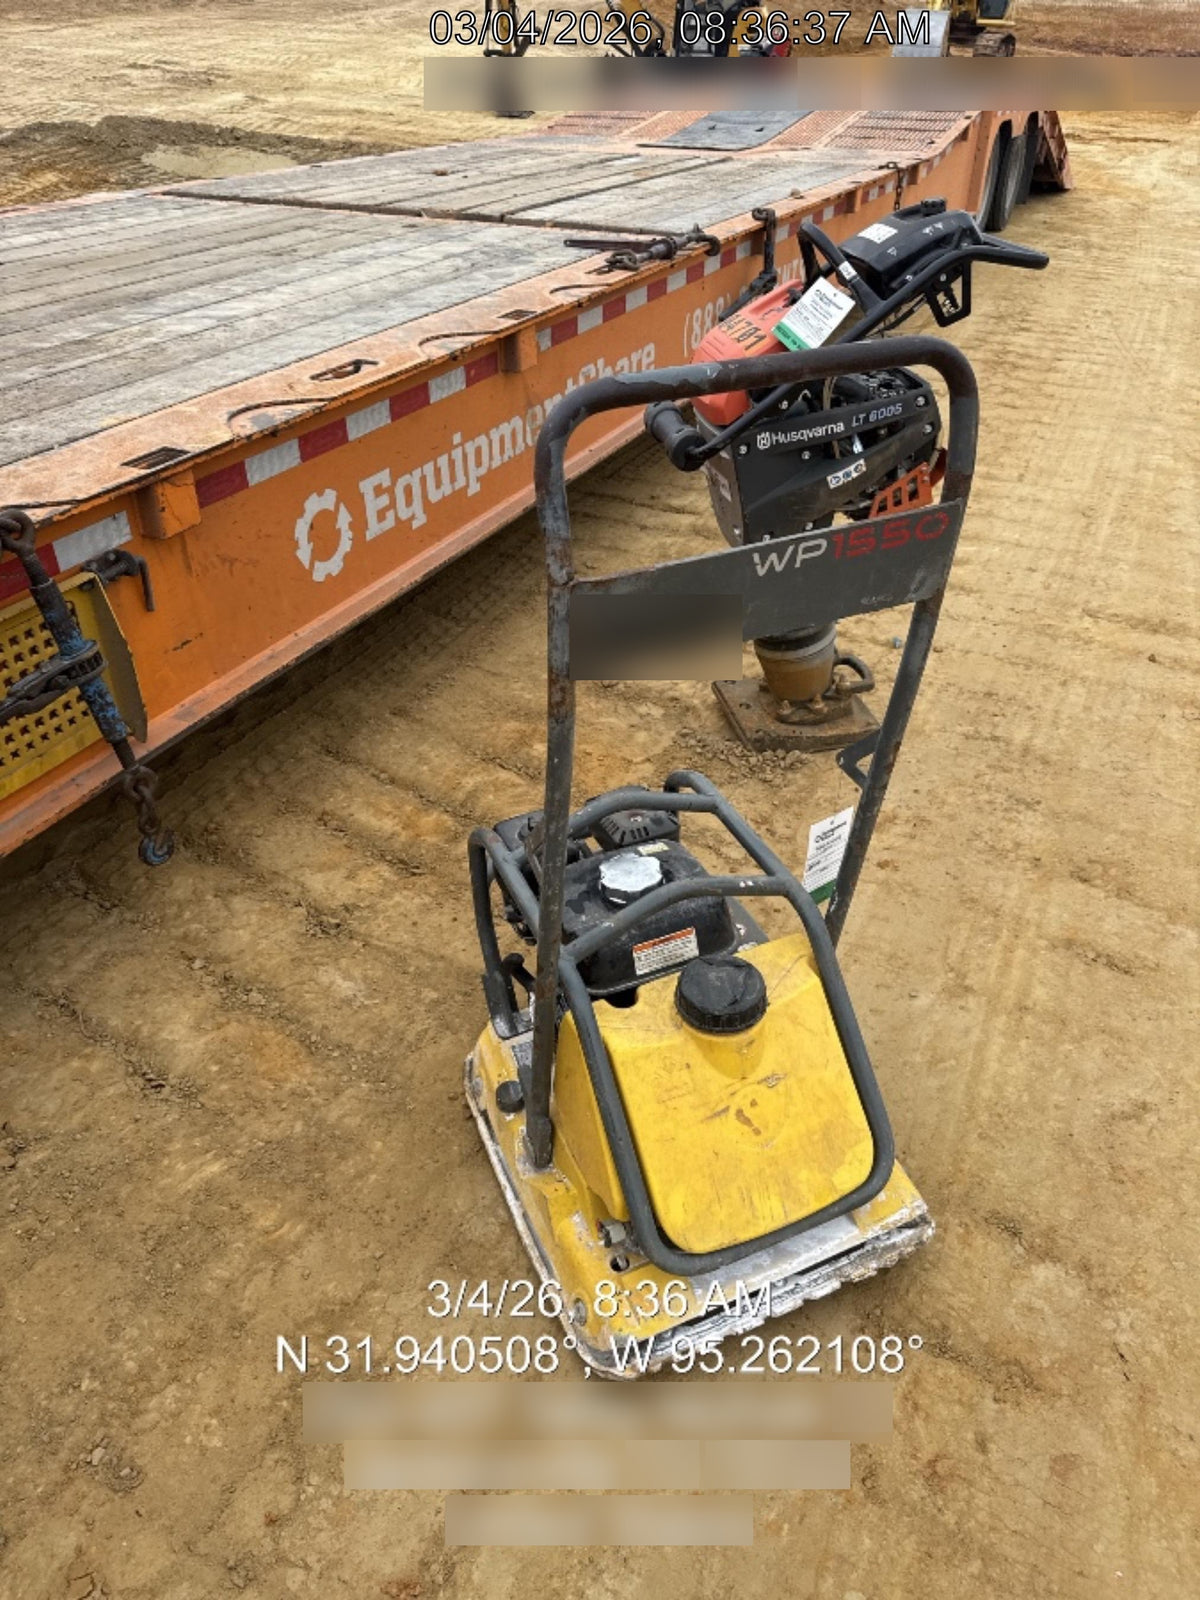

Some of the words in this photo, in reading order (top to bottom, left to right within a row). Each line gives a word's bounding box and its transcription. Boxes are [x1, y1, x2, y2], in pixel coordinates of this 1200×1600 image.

[772, 421, 845, 446] Husqvarna
[851, 413, 866, 428] LT
[752, 511, 950, 577] WP1550
